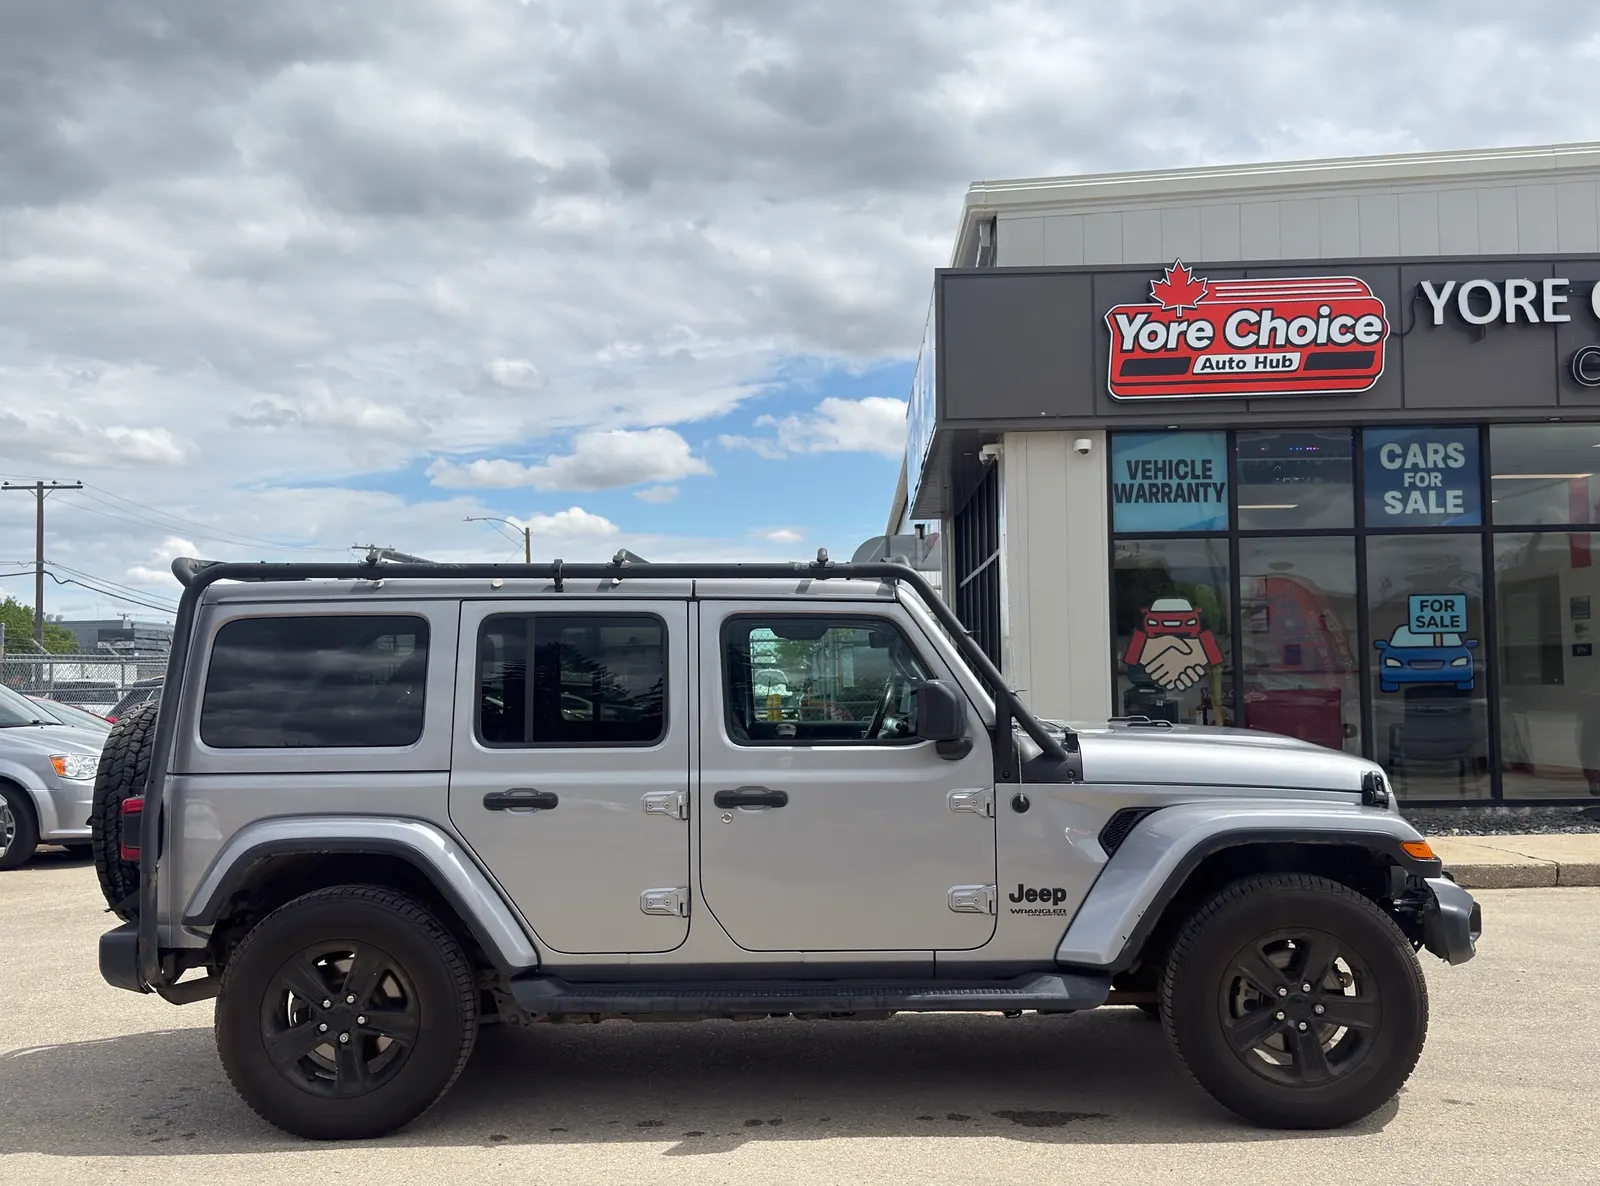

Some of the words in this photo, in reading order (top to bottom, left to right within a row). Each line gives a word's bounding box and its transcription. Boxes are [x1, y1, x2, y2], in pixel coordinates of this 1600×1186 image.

[1420, 278, 1571, 325] YORE
[1114, 313, 1214, 350] Yore
[1224, 305, 1383, 348] Choice
[1200, 356, 1247, 371] Auto
[1254, 355, 1293, 369] Hub
[1380, 442, 1466, 470] CARS
[1126, 459, 1213, 480] VEHICLE
[1403, 472, 1442, 488] FOR
[1113, 482, 1226, 503] WARRANTY
[1383, 490, 1464, 515] SALE
[1420, 599, 1456, 613] FOR
[1415, 615, 1460, 629] SALE
[1008, 883, 1067, 906] Jeep
